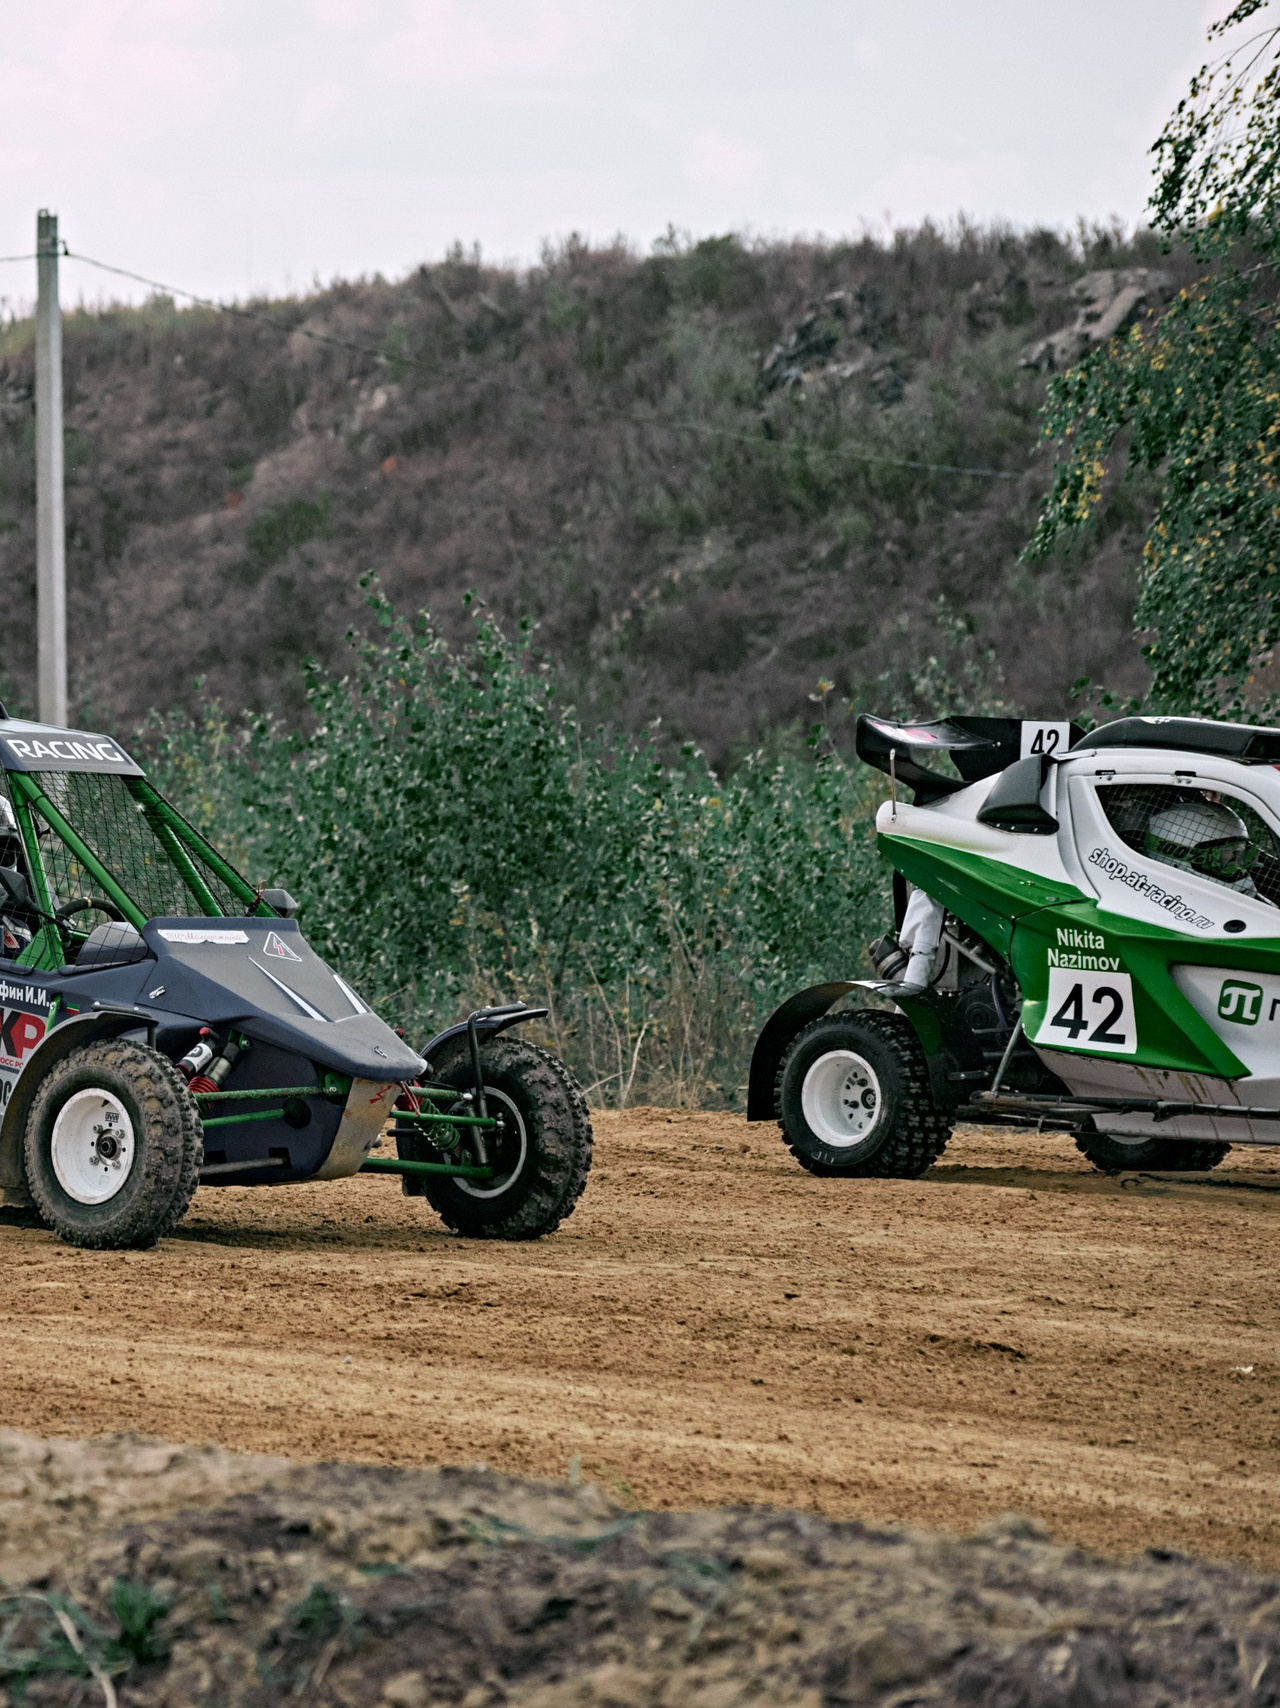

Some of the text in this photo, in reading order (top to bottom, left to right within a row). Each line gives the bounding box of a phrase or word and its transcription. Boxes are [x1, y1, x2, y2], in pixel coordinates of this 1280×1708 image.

[6, 739, 125, 762] RACING
[1030, 729, 1060, 754] 42
[1087, 847, 1216, 930] shop.at-racing.ru
[1056, 927, 1105, 949] Nikita
[1047, 947, 1120, 971] Nazimov
[1049, 983, 1126, 1045] 42
